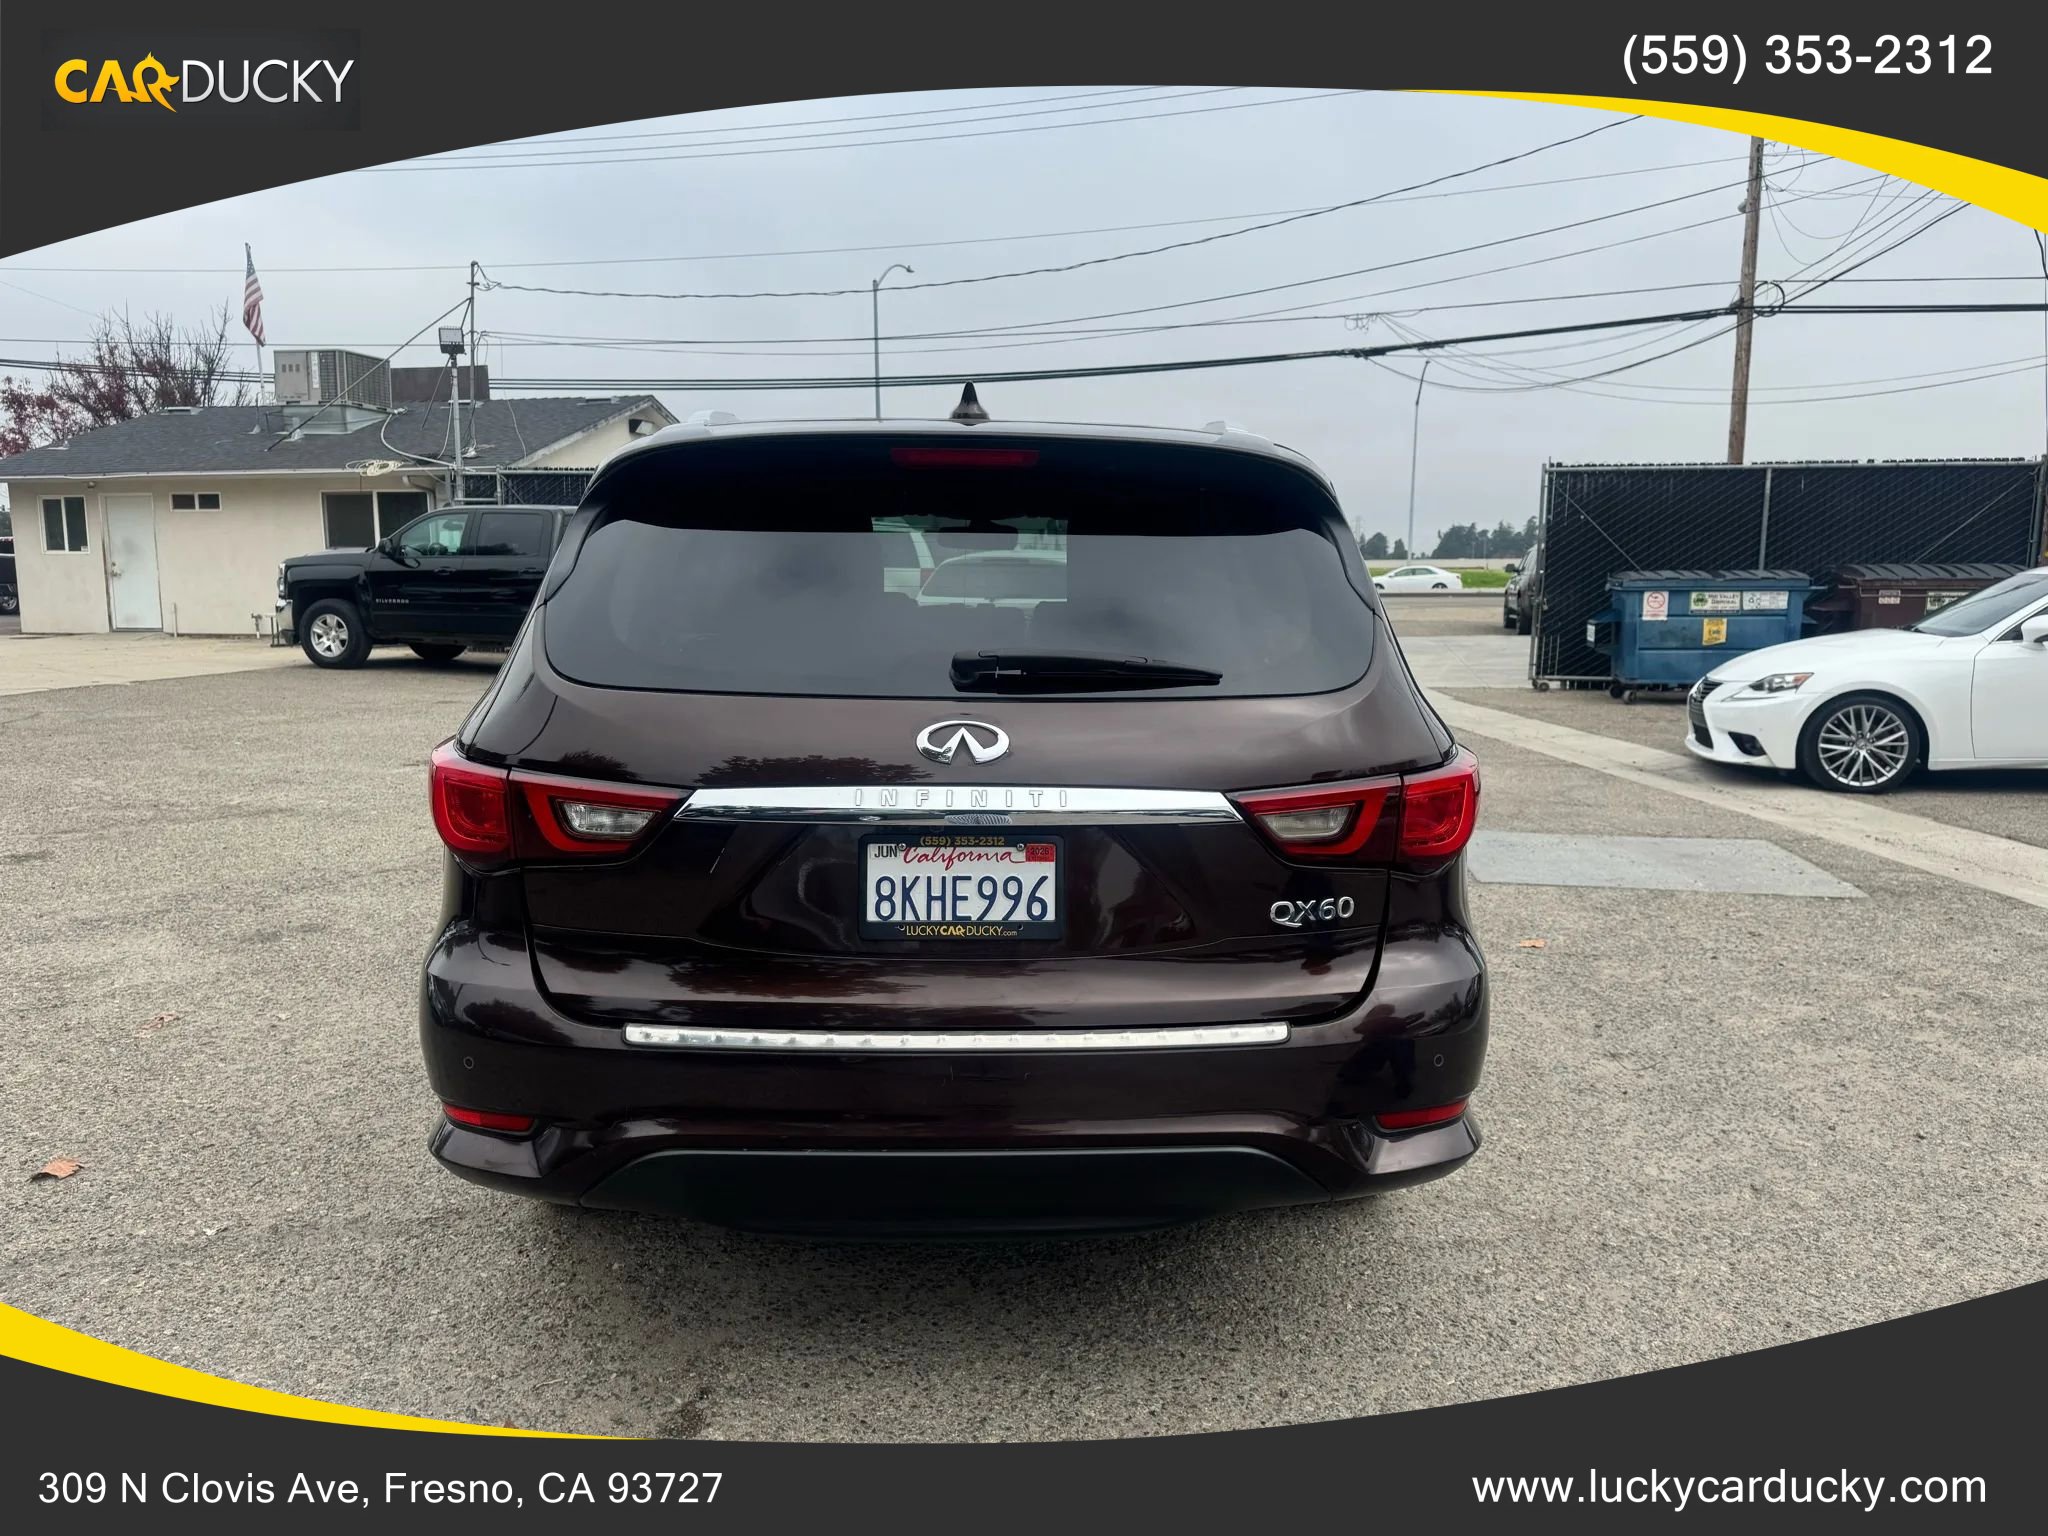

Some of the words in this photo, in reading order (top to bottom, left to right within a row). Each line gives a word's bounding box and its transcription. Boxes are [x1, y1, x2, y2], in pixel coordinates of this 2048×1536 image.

[855, 789, 1067, 807] INFINITI
[874, 846, 898, 858] JUN
[920, 836, 951, 847] (559)
[954, 836, 1005, 847] 353-2312
[902, 847, 1025, 871] California
[874, 876, 1049, 921] 8KHE996
[1270, 896, 1355, 928] QX60
